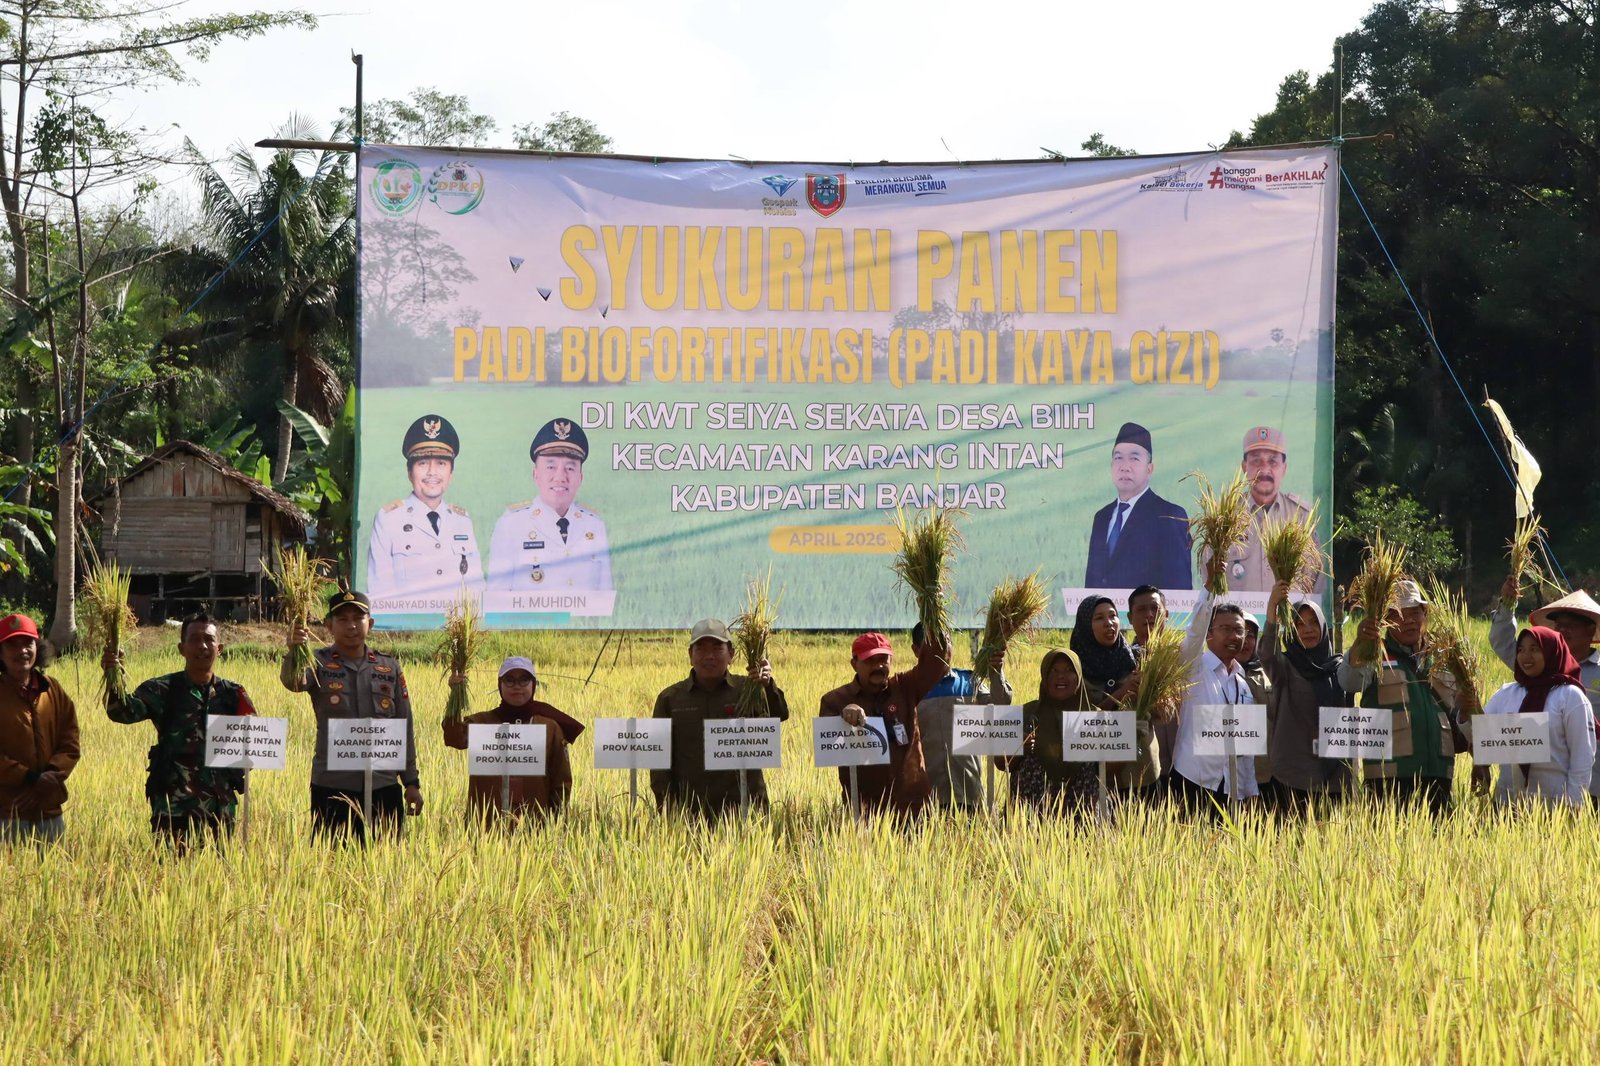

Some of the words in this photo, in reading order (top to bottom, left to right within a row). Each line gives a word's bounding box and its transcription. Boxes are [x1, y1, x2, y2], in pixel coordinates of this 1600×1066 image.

[1223, 168, 1256, 176] bangga
[1265, 170, 1325, 183] BerAKHLAK
[1224, 175, 1262, 184] melayani
[864, 183, 916, 196] MERANGKUL
[917, 180, 946, 192] SEMUA
[1169, 181, 1203, 189] Bekerja
[1225, 182, 1255, 191] bangsa
[559, 224, 892, 312] SYUKURAN
[917, 228, 1118, 314] PANEN
[453, 326, 546, 383] PADI
[561, 326, 873, 384] BIOFORTIFIKASI
[888, 328, 998, 389] (PADI
[1013, 329, 1114, 385] KAYA
[1129, 329, 1221, 391] GIZI)
[580, 401, 614, 429] DI
[624, 402, 699, 430] KWT
[706, 402, 798, 430] SEIYA
[805, 403, 929, 431] SEKATA
[937, 403, 1023, 431] DESA
[1031, 402, 1095, 430] BIIH
[611, 443, 813, 471] KECAMATAN
[823, 443, 958, 471] KARANG
[968, 442, 1064, 469] INTAN
[671, 483, 865, 512] KABUPATEN
[876, 482, 1007, 510] BANJAR
[789, 532, 841, 546] APRIL
[845, 532, 886, 546] 2026
[370, 600, 427, 609] ASNURYADI
[512, 597, 525, 608] H.
[529, 596, 586, 608] MUHIDIN
[957, 719, 992, 727] KEPALA
[1222, 718, 1239, 726] BPS
[1341, 715, 1372, 723] CAMAT
[226, 723, 269, 733] KORAMIL
[350, 726, 386, 734] POLSEK
[710, 726, 746, 734] KEPALA
[747, 725, 776, 733] DINAS
[1324, 727, 1361, 735] KARANG
[1362, 728, 1389, 736] INTAN
[1501, 727, 1522, 735] KWT
[494, 732, 521, 740] BANK
[617, 732, 649, 740] BULOG
[820, 730, 856, 739] KEPALA
[960, 731, 988, 739] PROV.
[989, 731, 1018, 739] KALSEL
[1228, 730, 1260, 738] KALSEL
[211, 735, 251, 745] KARANG
[253, 737, 282, 746] INTAN
[333, 738, 372, 746] KARANG
[374, 738, 403, 746] INTAN
[717, 738, 769, 746] PERTANIAN
[1327, 739, 1348, 747] KAB.
[1350, 739, 1385, 748] BANJAR
[1509, 738, 1544, 746] SEKATA
[482, 743, 533, 751] INDONESIA
[602, 744, 628, 752] PROV
[630, 744, 663, 752] KALSEL
[820, 742, 848, 751] PROV.
[850, 741, 884, 749] KALSEL
[1070, 743, 1098, 751] PROV.
[213, 748, 242, 757] PROV.
[244, 749, 278, 758] KALSEL
[337, 751, 359, 759] KAB.
[360, 751, 398, 759] BANJAR
[713, 751, 735, 759] KAB.
[736, 750, 773, 758] BANJAR
[475, 756, 504, 764] PROV.
[505, 756, 539, 764] KALSEL
